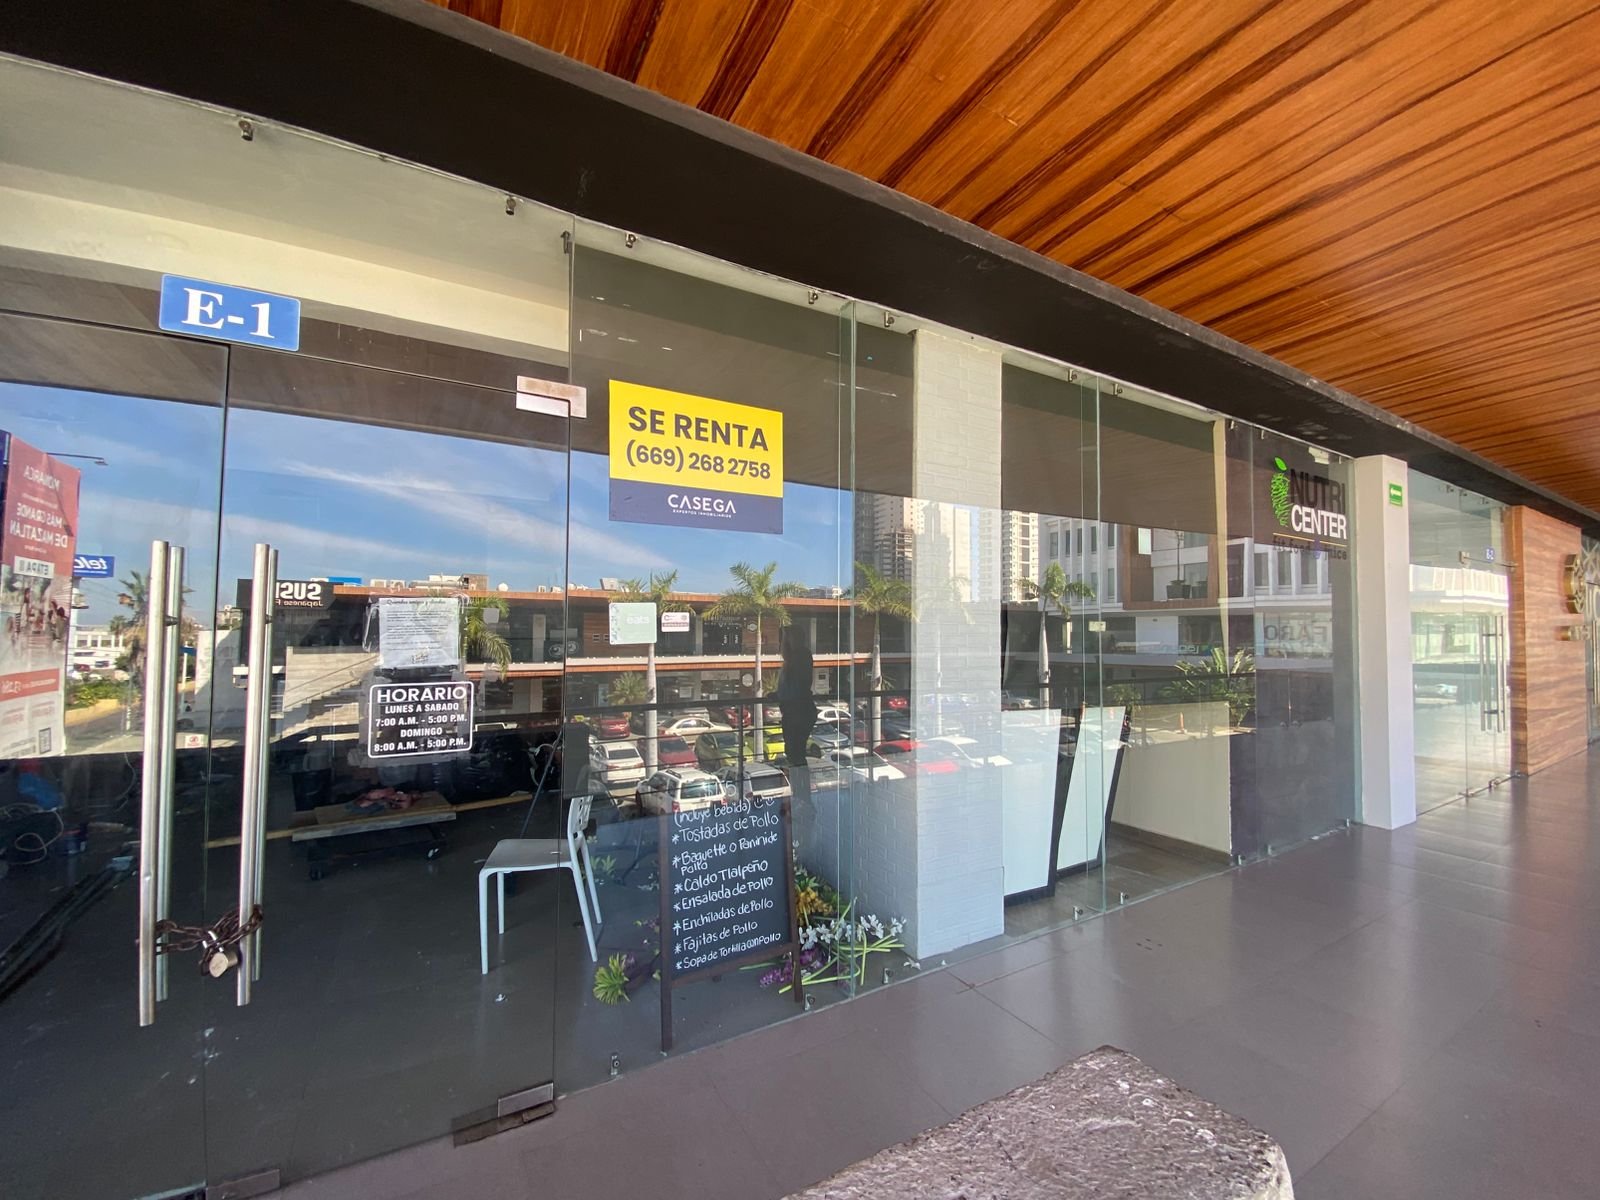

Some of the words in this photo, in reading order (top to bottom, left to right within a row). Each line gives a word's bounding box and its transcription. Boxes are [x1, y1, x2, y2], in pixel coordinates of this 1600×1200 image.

[181, 287, 275, 339] E-1
[628, 406, 665, 435] SE
[674, 413, 769, 452] RENTA
[625, 439, 684, 473] (669)
[688, 452, 725, 474] 268
[727, 458, 771, 480] 2758
[1290, 468, 1346, 515] NUTRI
[667, 493, 737, 514] CASEGA
[1291, 504, 1347, 539] CENTER
[377, 686, 467, 703] HORARIO
[385, 704, 413, 714] LUNES
[416, 704, 422, 712] A
[424, 702, 459, 712] SABADO
[375, 717, 396, 727] 7:00
[398, 716, 419, 726] A.M.
[428, 715, 447, 724] 5:00
[450, 714, 467, 722] P.M.
[400, 727, 443, 738] DOMINGO
[374, 742, 395, 752] 8:00
[397, 741, 418, 750] A.M.
[427, 738, 447, 748] 5:00
[449, 738, 467, 746] P.M.
[714, 798, 751, 818] bebida)
[679, 822, 731, 842] Tostadas
[733, 817, 748, 831] de
[749, 811, 779, 828] Pollo
[681, 843, 727, 865] Baguette
[681, 884, 731, 910] Ensalada
[732, 883, 747, 896] de
[747, 876, 774, 892] Pollo
[684, 873, 718, 892] Caldo
[682, 907, 736, 931] Enchiladas
[683, 932, 718, 953] Fajitas
[719, 927, 731, 940] de
[733, 921, 758, 935] Pollo
[683, 954, 707, 969] Sopa
